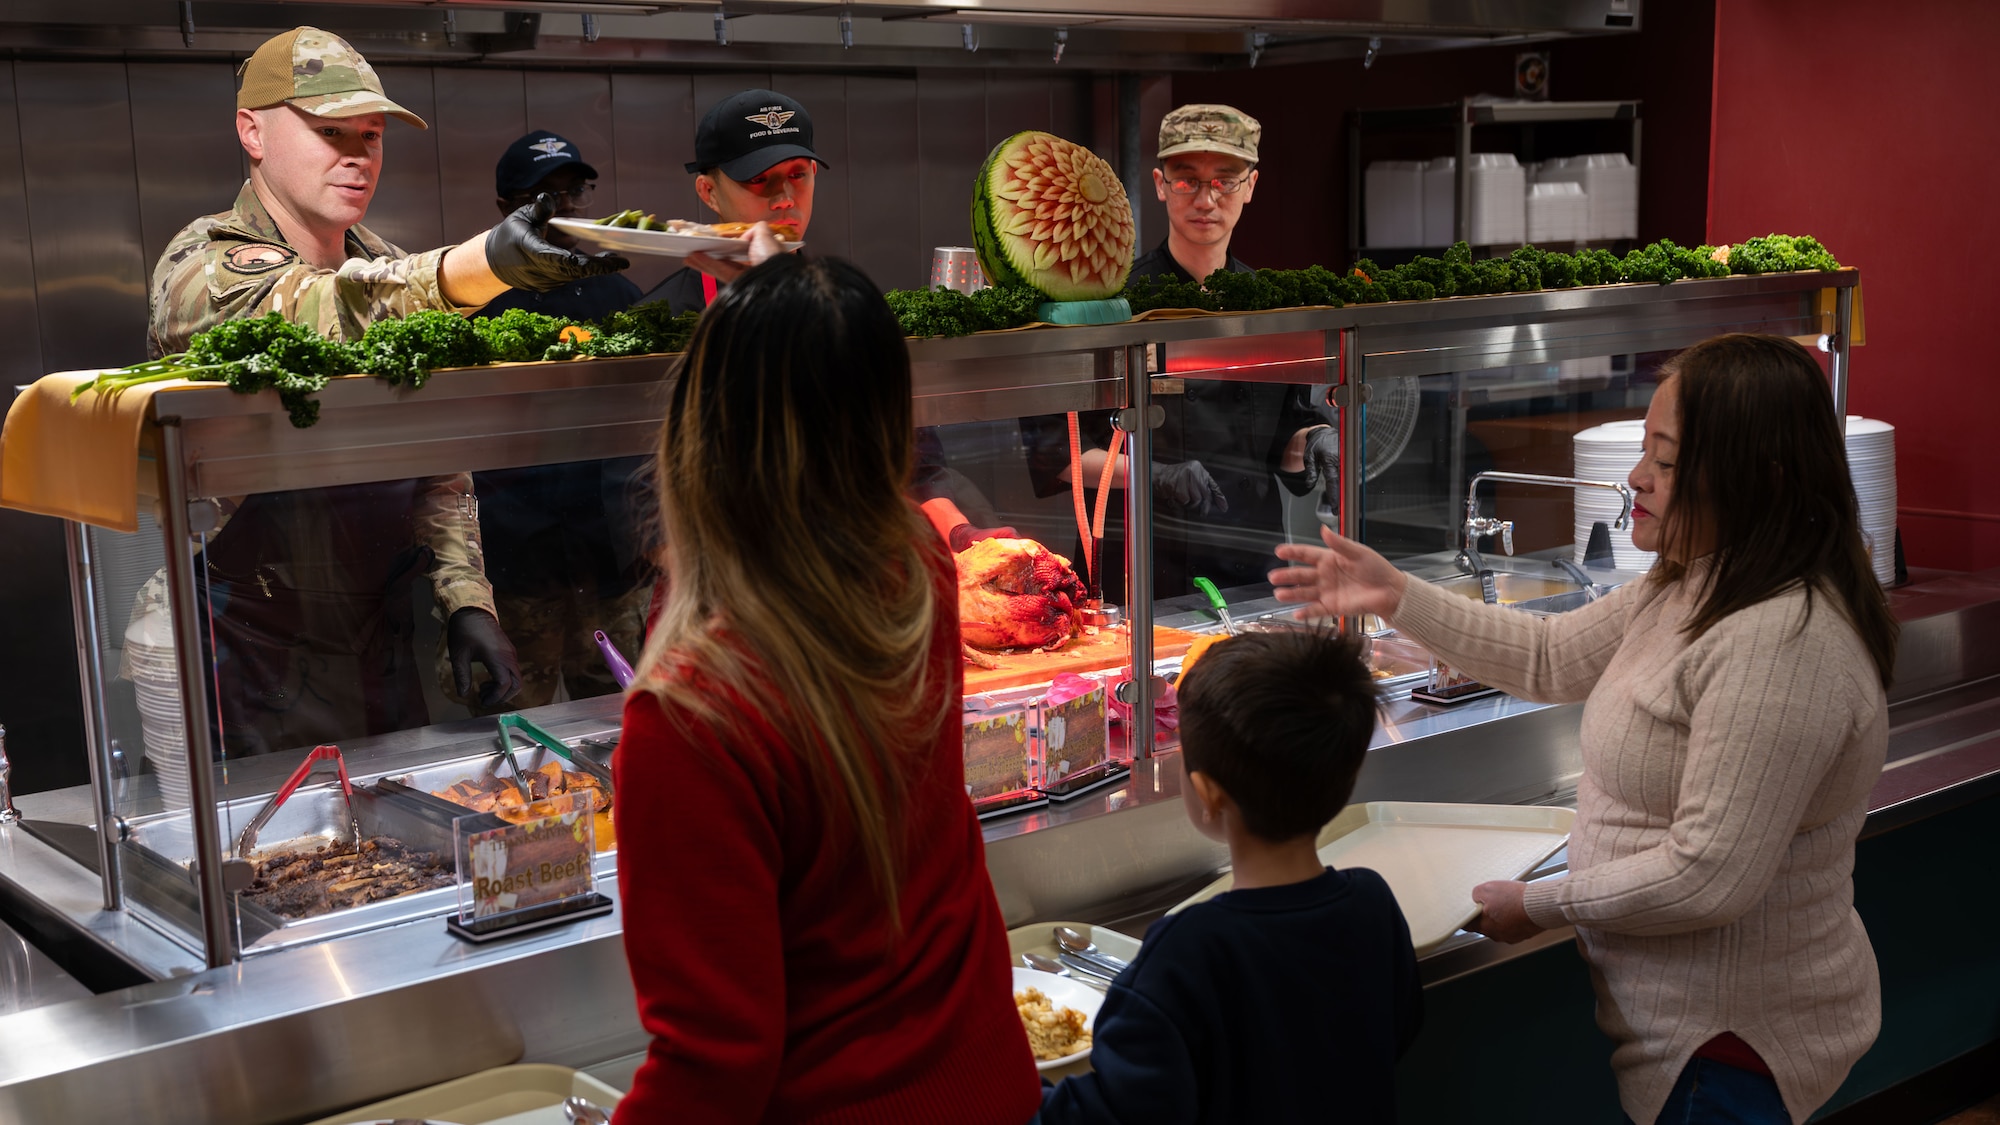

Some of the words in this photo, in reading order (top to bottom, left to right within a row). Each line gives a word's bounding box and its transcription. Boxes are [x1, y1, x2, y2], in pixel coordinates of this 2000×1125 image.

[750, 131, 766, 139] FOOD
[477, 867, 533, 898] Roast
[540, 854, 584, 883] Beef
